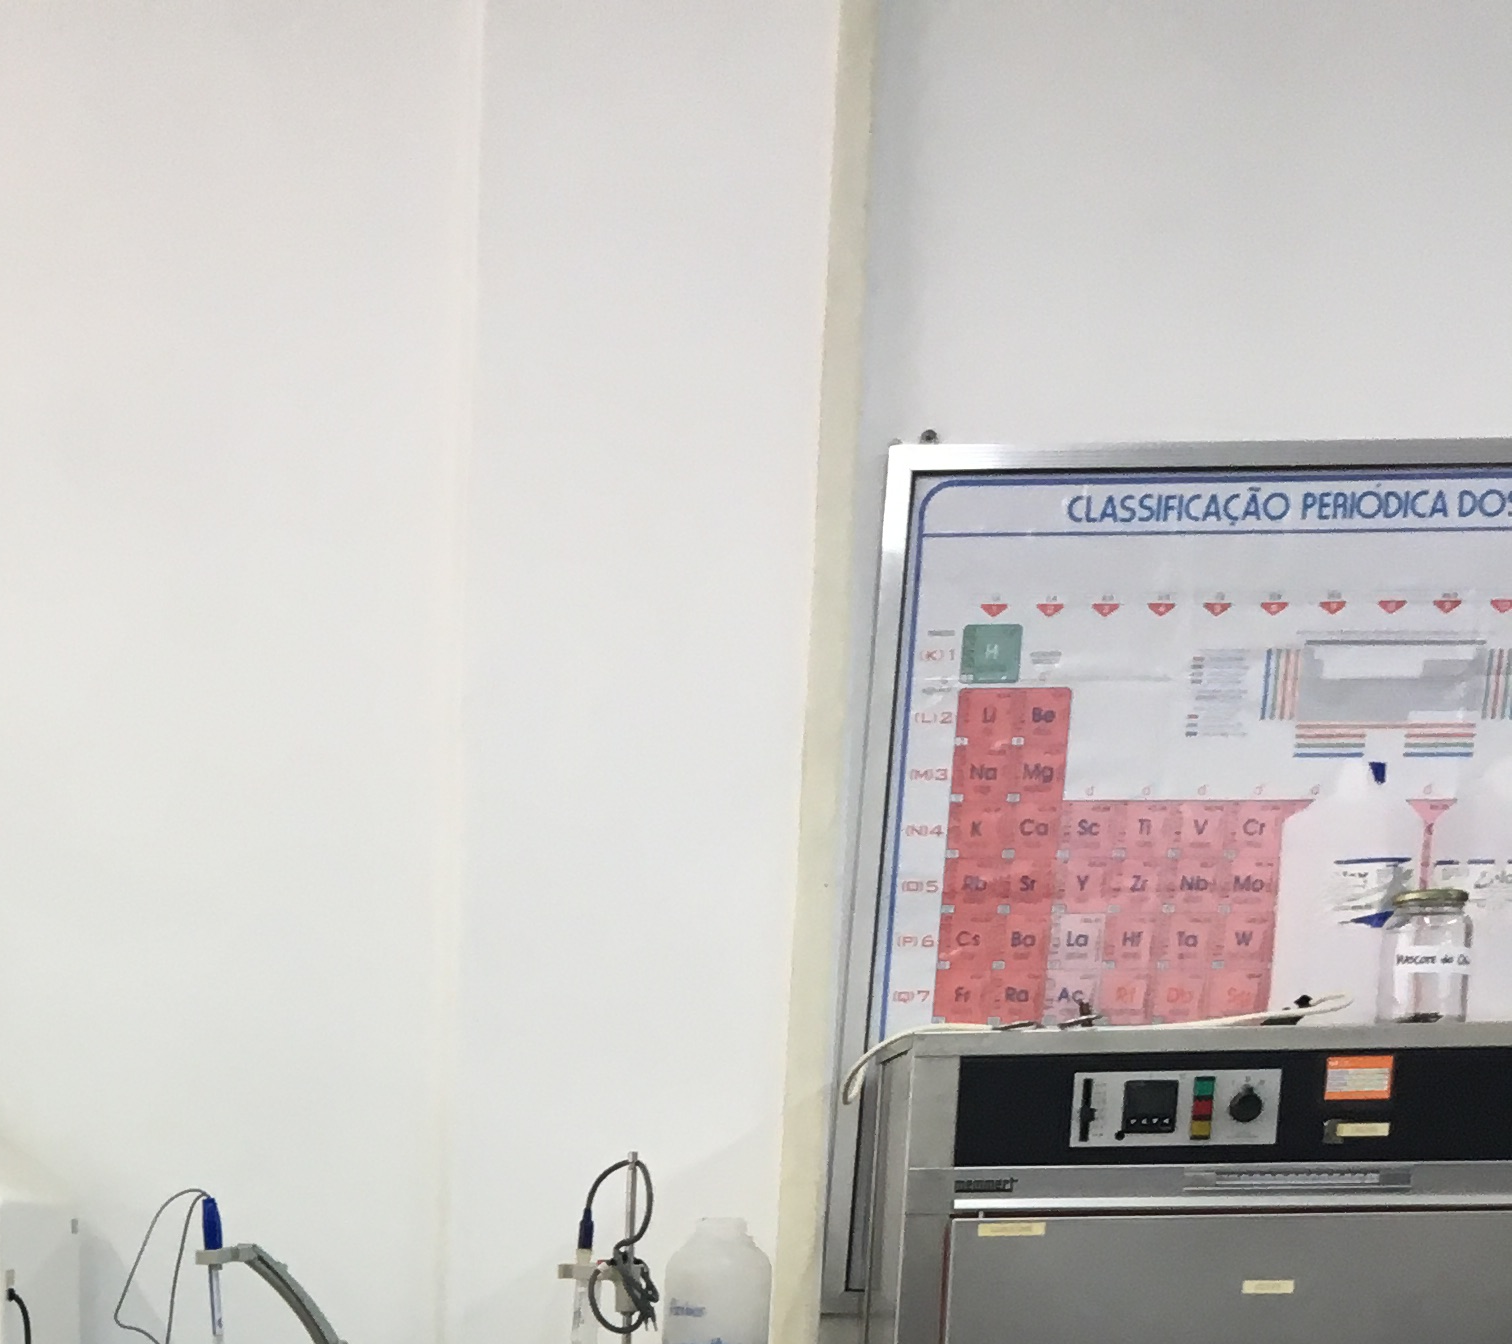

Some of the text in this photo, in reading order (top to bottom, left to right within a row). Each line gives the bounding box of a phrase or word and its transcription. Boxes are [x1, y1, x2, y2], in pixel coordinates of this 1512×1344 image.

[1067, 483, 1512, 526] CLASSIFICAÇÃO PERIÓDICA DO
[970, 764, 998, 781] Na
[1023, 763, 1054, 784] Mg
[970, 821, 982, 838] K
[1019, 818, 1049, 837] Ca
[1077, 818, 1101, 836] Sc
[1193, 819, 1208, 836] V
[1242, 818, 1266, 837] Cr
[1077, 875, 1089, 892] Y
[1179, 875, 1209, 891] Nb
[1233, 875, 1265, 893] Mo
[955, 931, 981, 948] Cs
[1010, 931, 1036, 948] Ba
[1066, 931, 1088, 948] La
[1235, 931, 1253, 946] W
